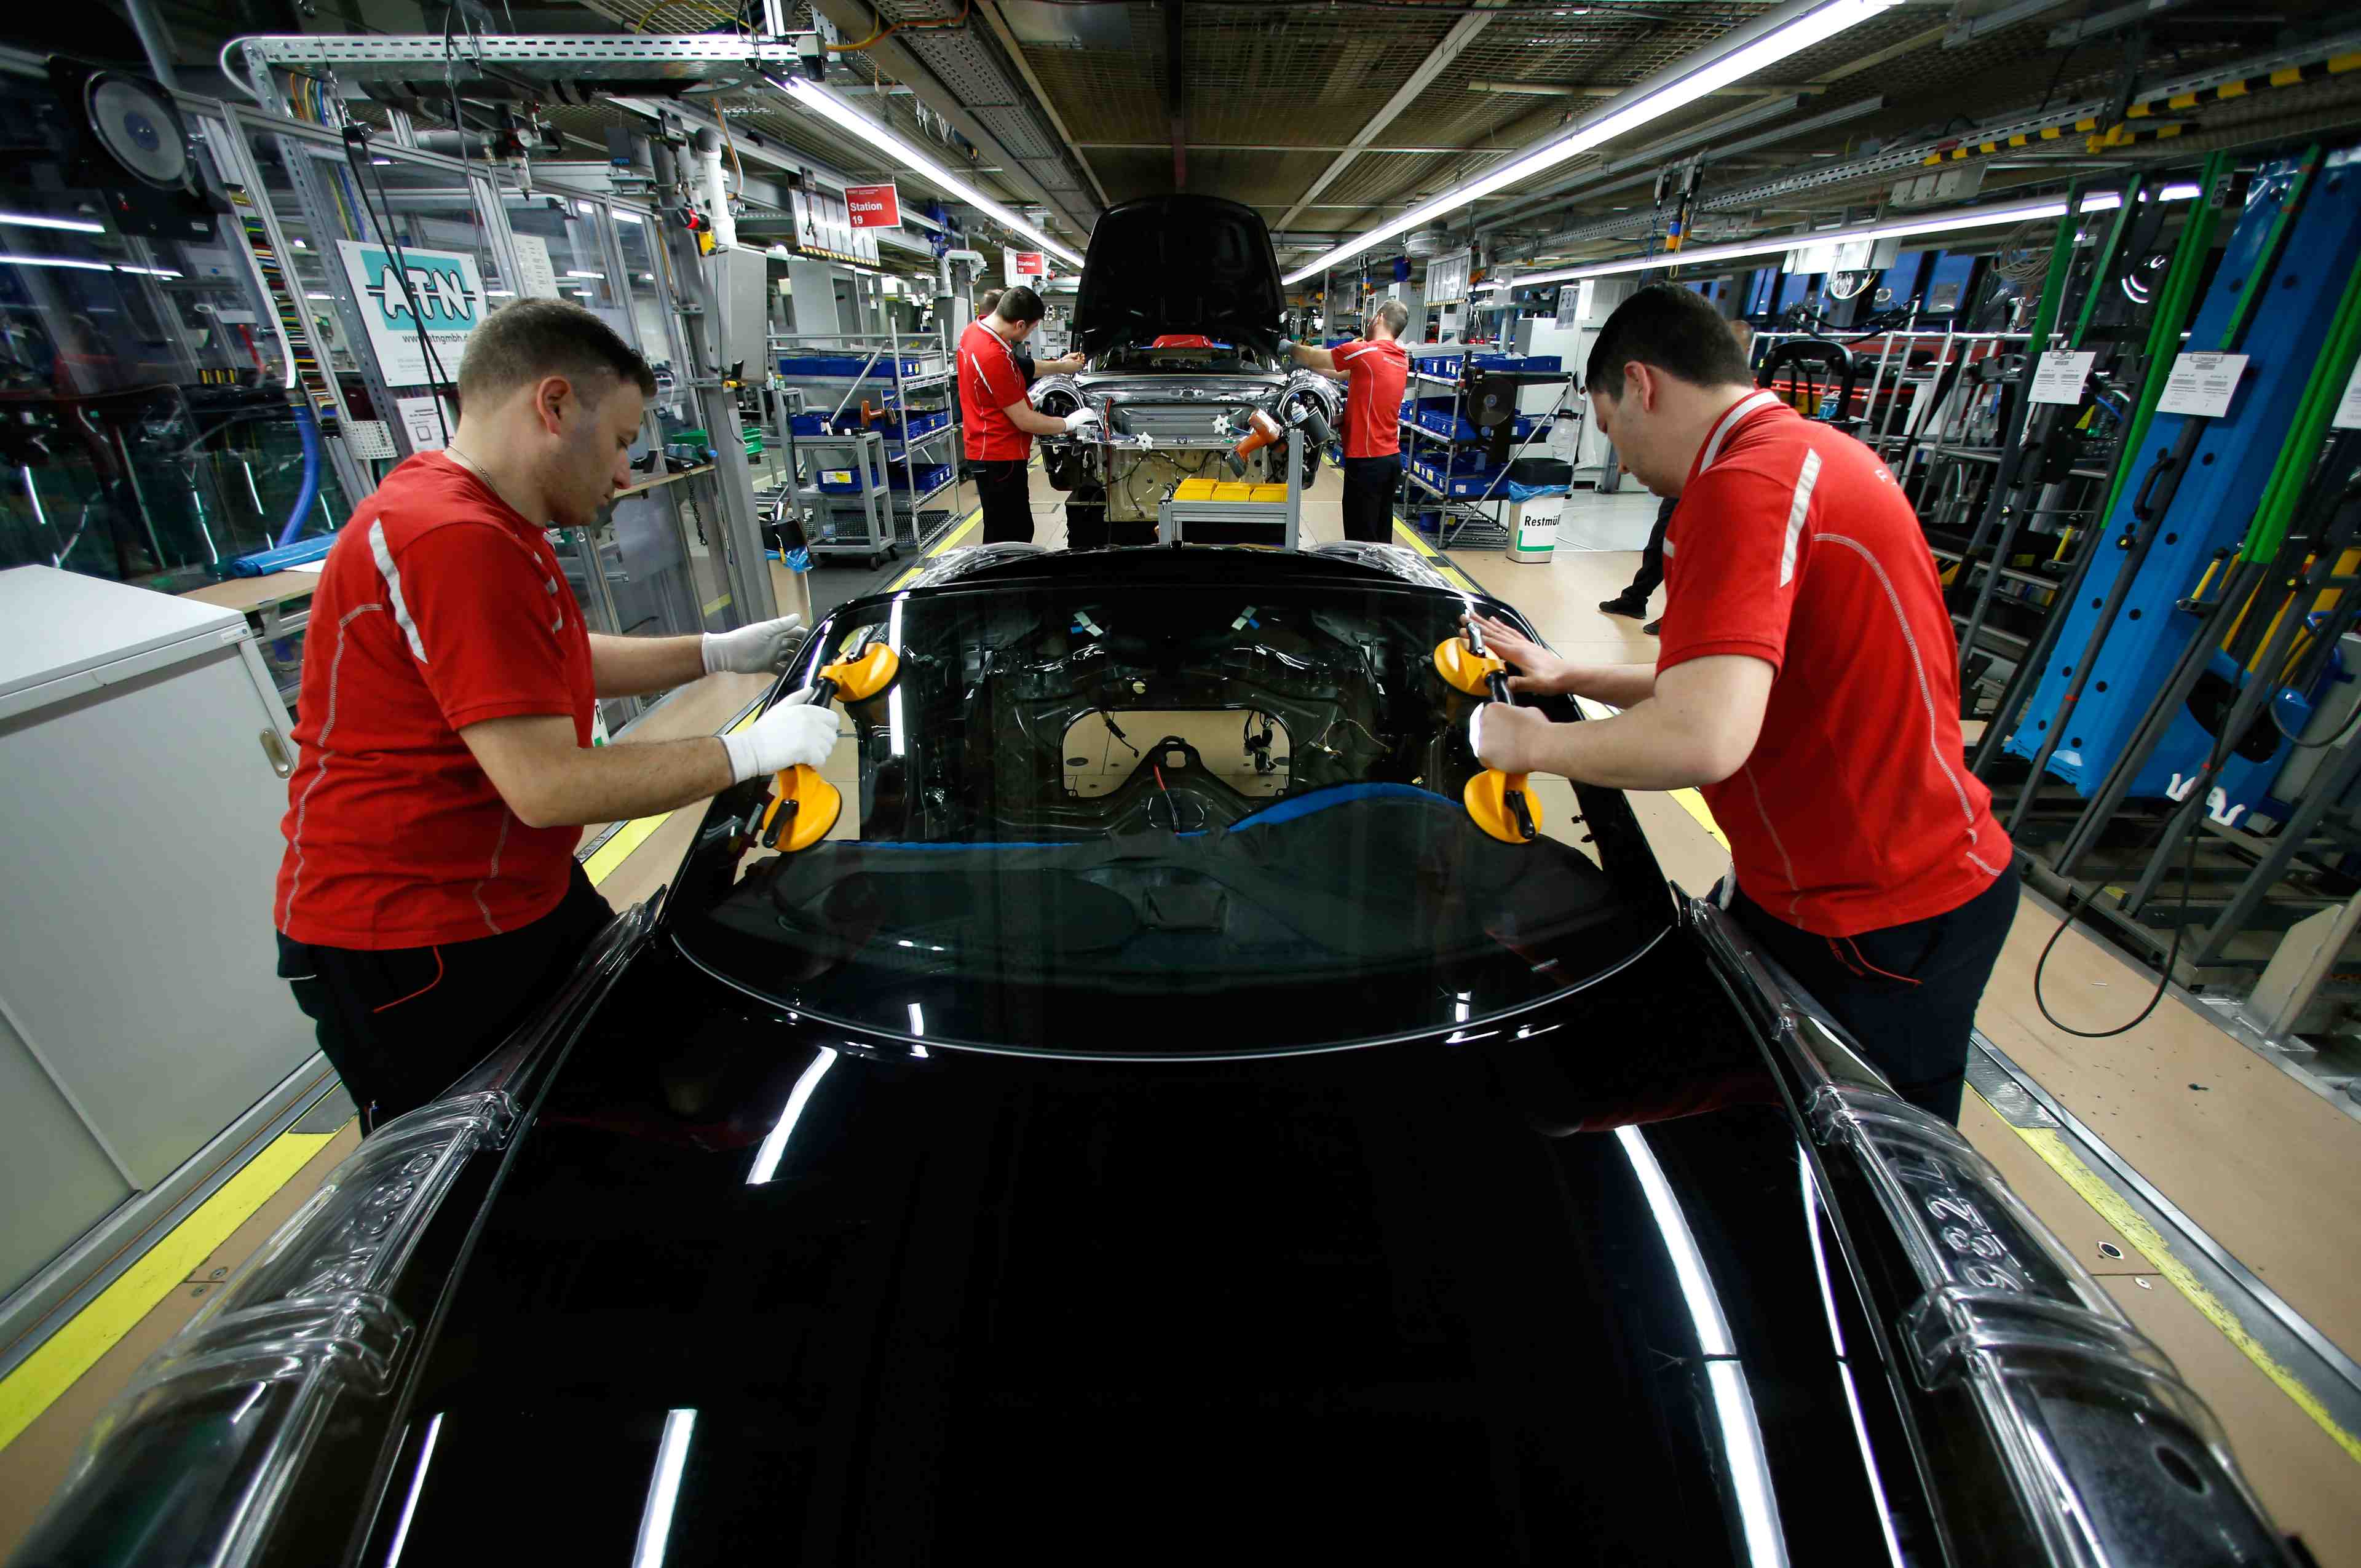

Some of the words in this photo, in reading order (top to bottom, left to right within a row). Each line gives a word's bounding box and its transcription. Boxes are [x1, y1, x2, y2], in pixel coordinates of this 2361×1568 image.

[850, 202, 882, 212] Station
[852, 216, 863, 224] 19
[382, 264, 472, 320] ATN
